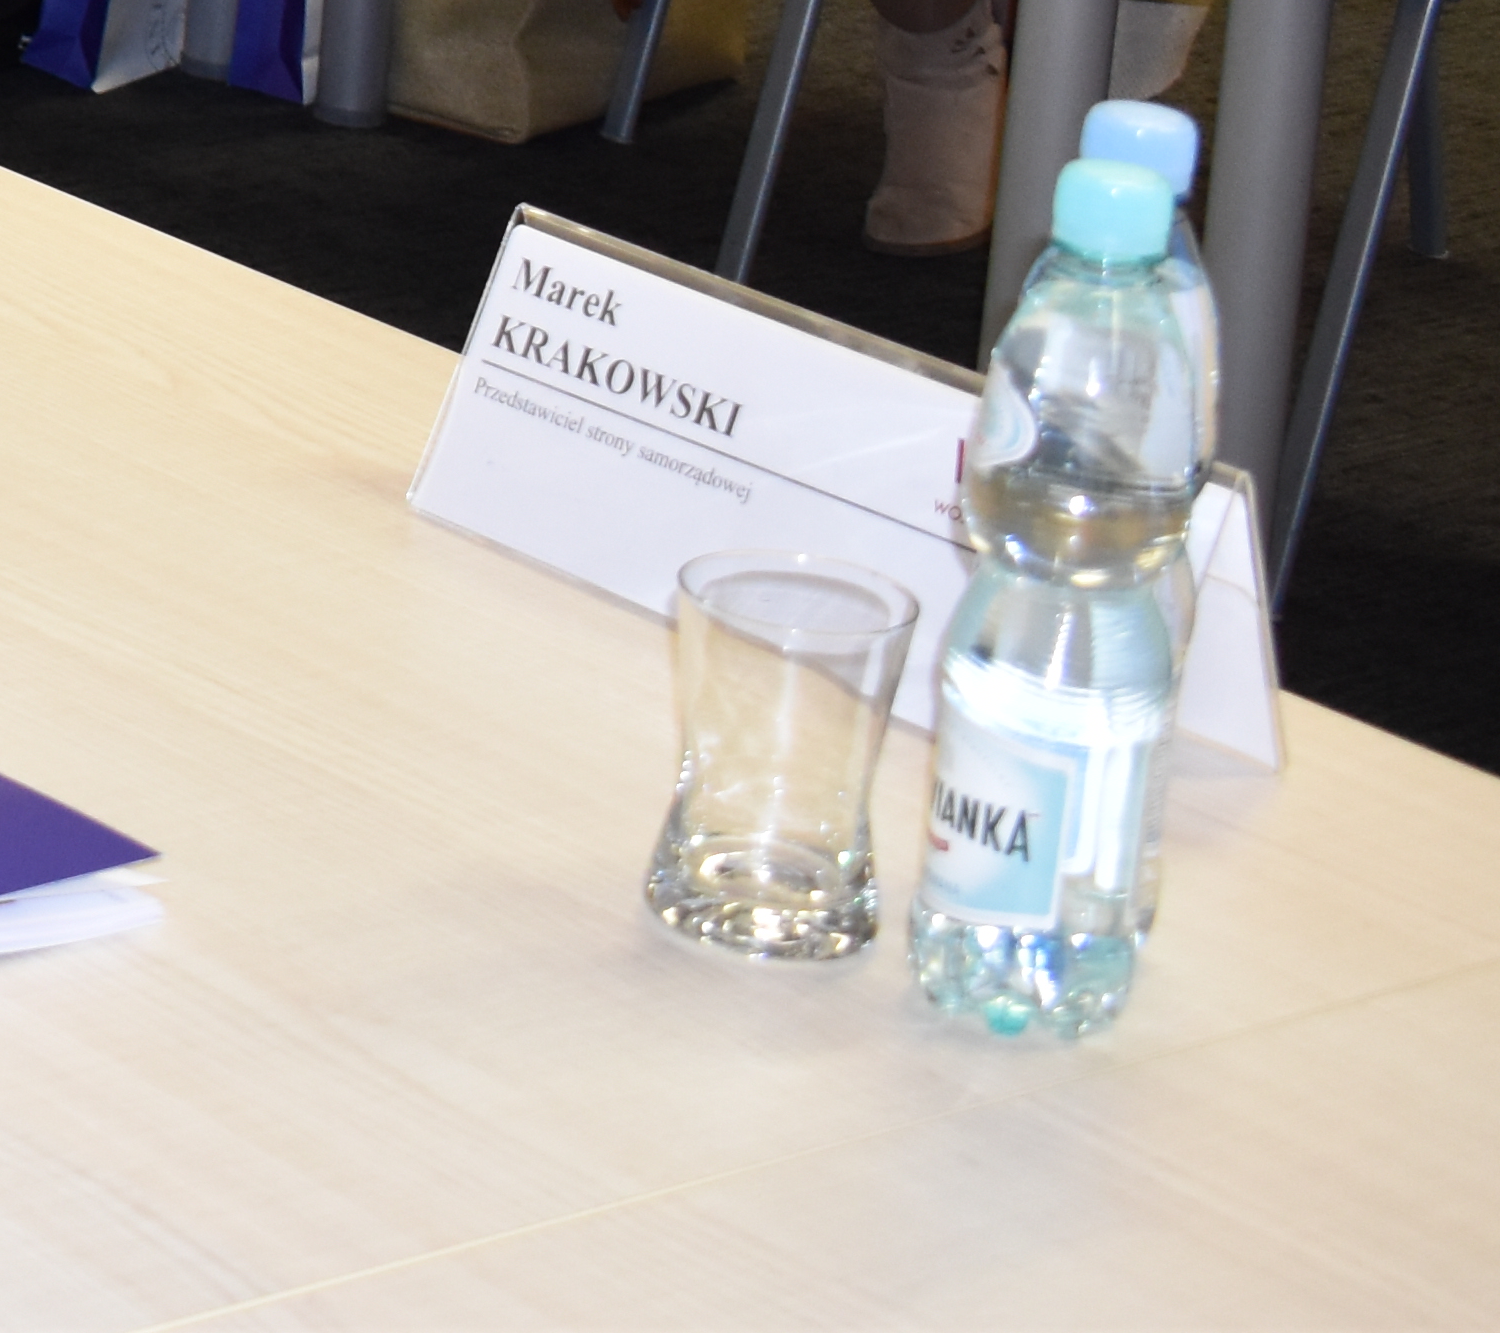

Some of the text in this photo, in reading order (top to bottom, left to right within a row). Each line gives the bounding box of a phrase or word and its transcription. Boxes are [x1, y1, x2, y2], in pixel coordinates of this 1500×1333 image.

[512, 257, 623, 328] Marek
[490, 313, 744, 438] KRAKOWSKI
[473, 376, 754, 506] Przedstawiciel strony samorządowej
